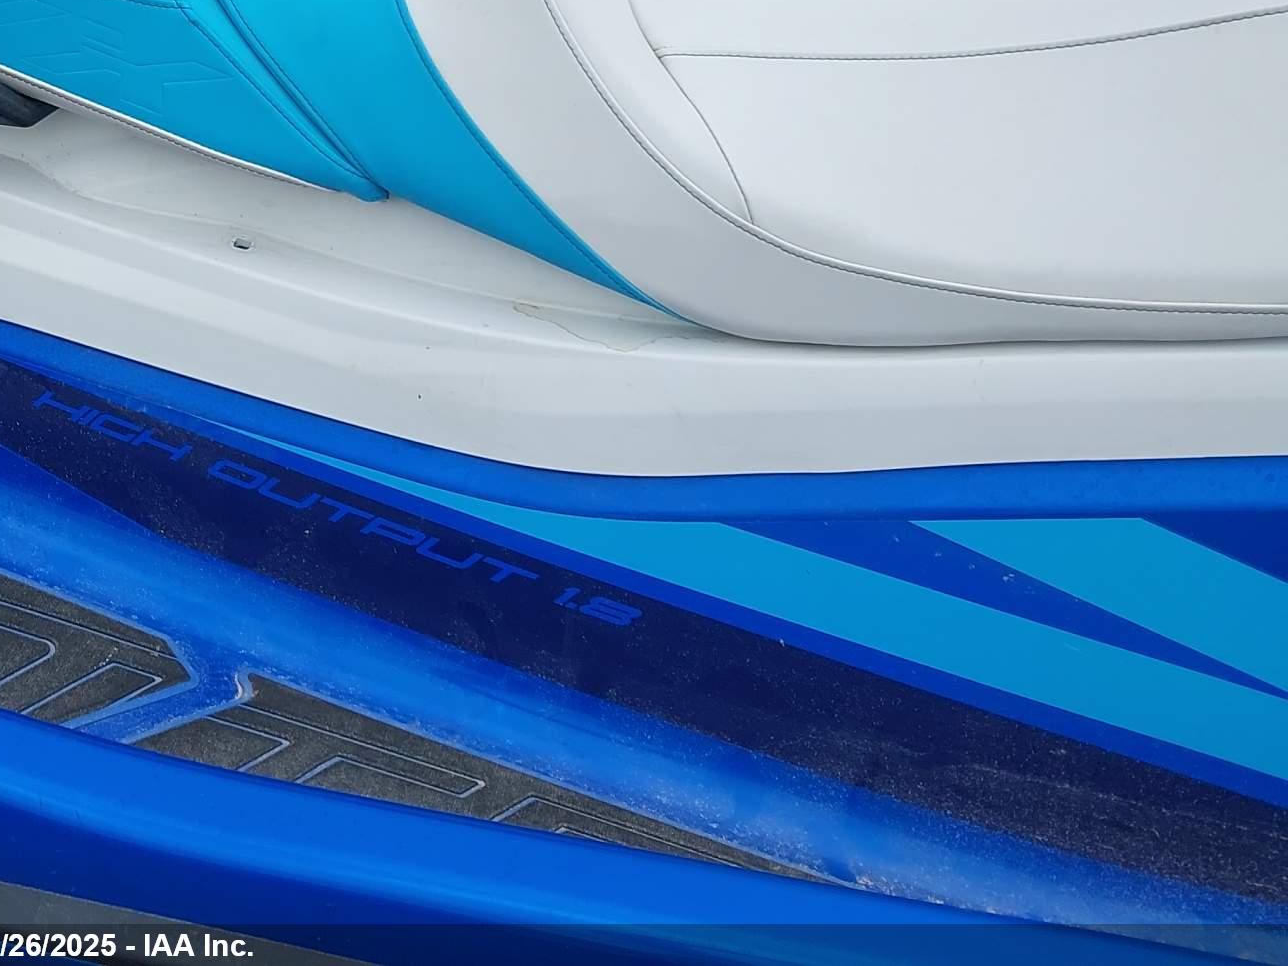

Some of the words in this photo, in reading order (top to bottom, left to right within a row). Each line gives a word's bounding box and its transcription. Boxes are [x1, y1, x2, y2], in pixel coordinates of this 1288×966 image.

[32, 389, 193, 462] HIGH
[207, 459, 539, 584] OUTPUT
[553, 587, 643, 626] 1.8
